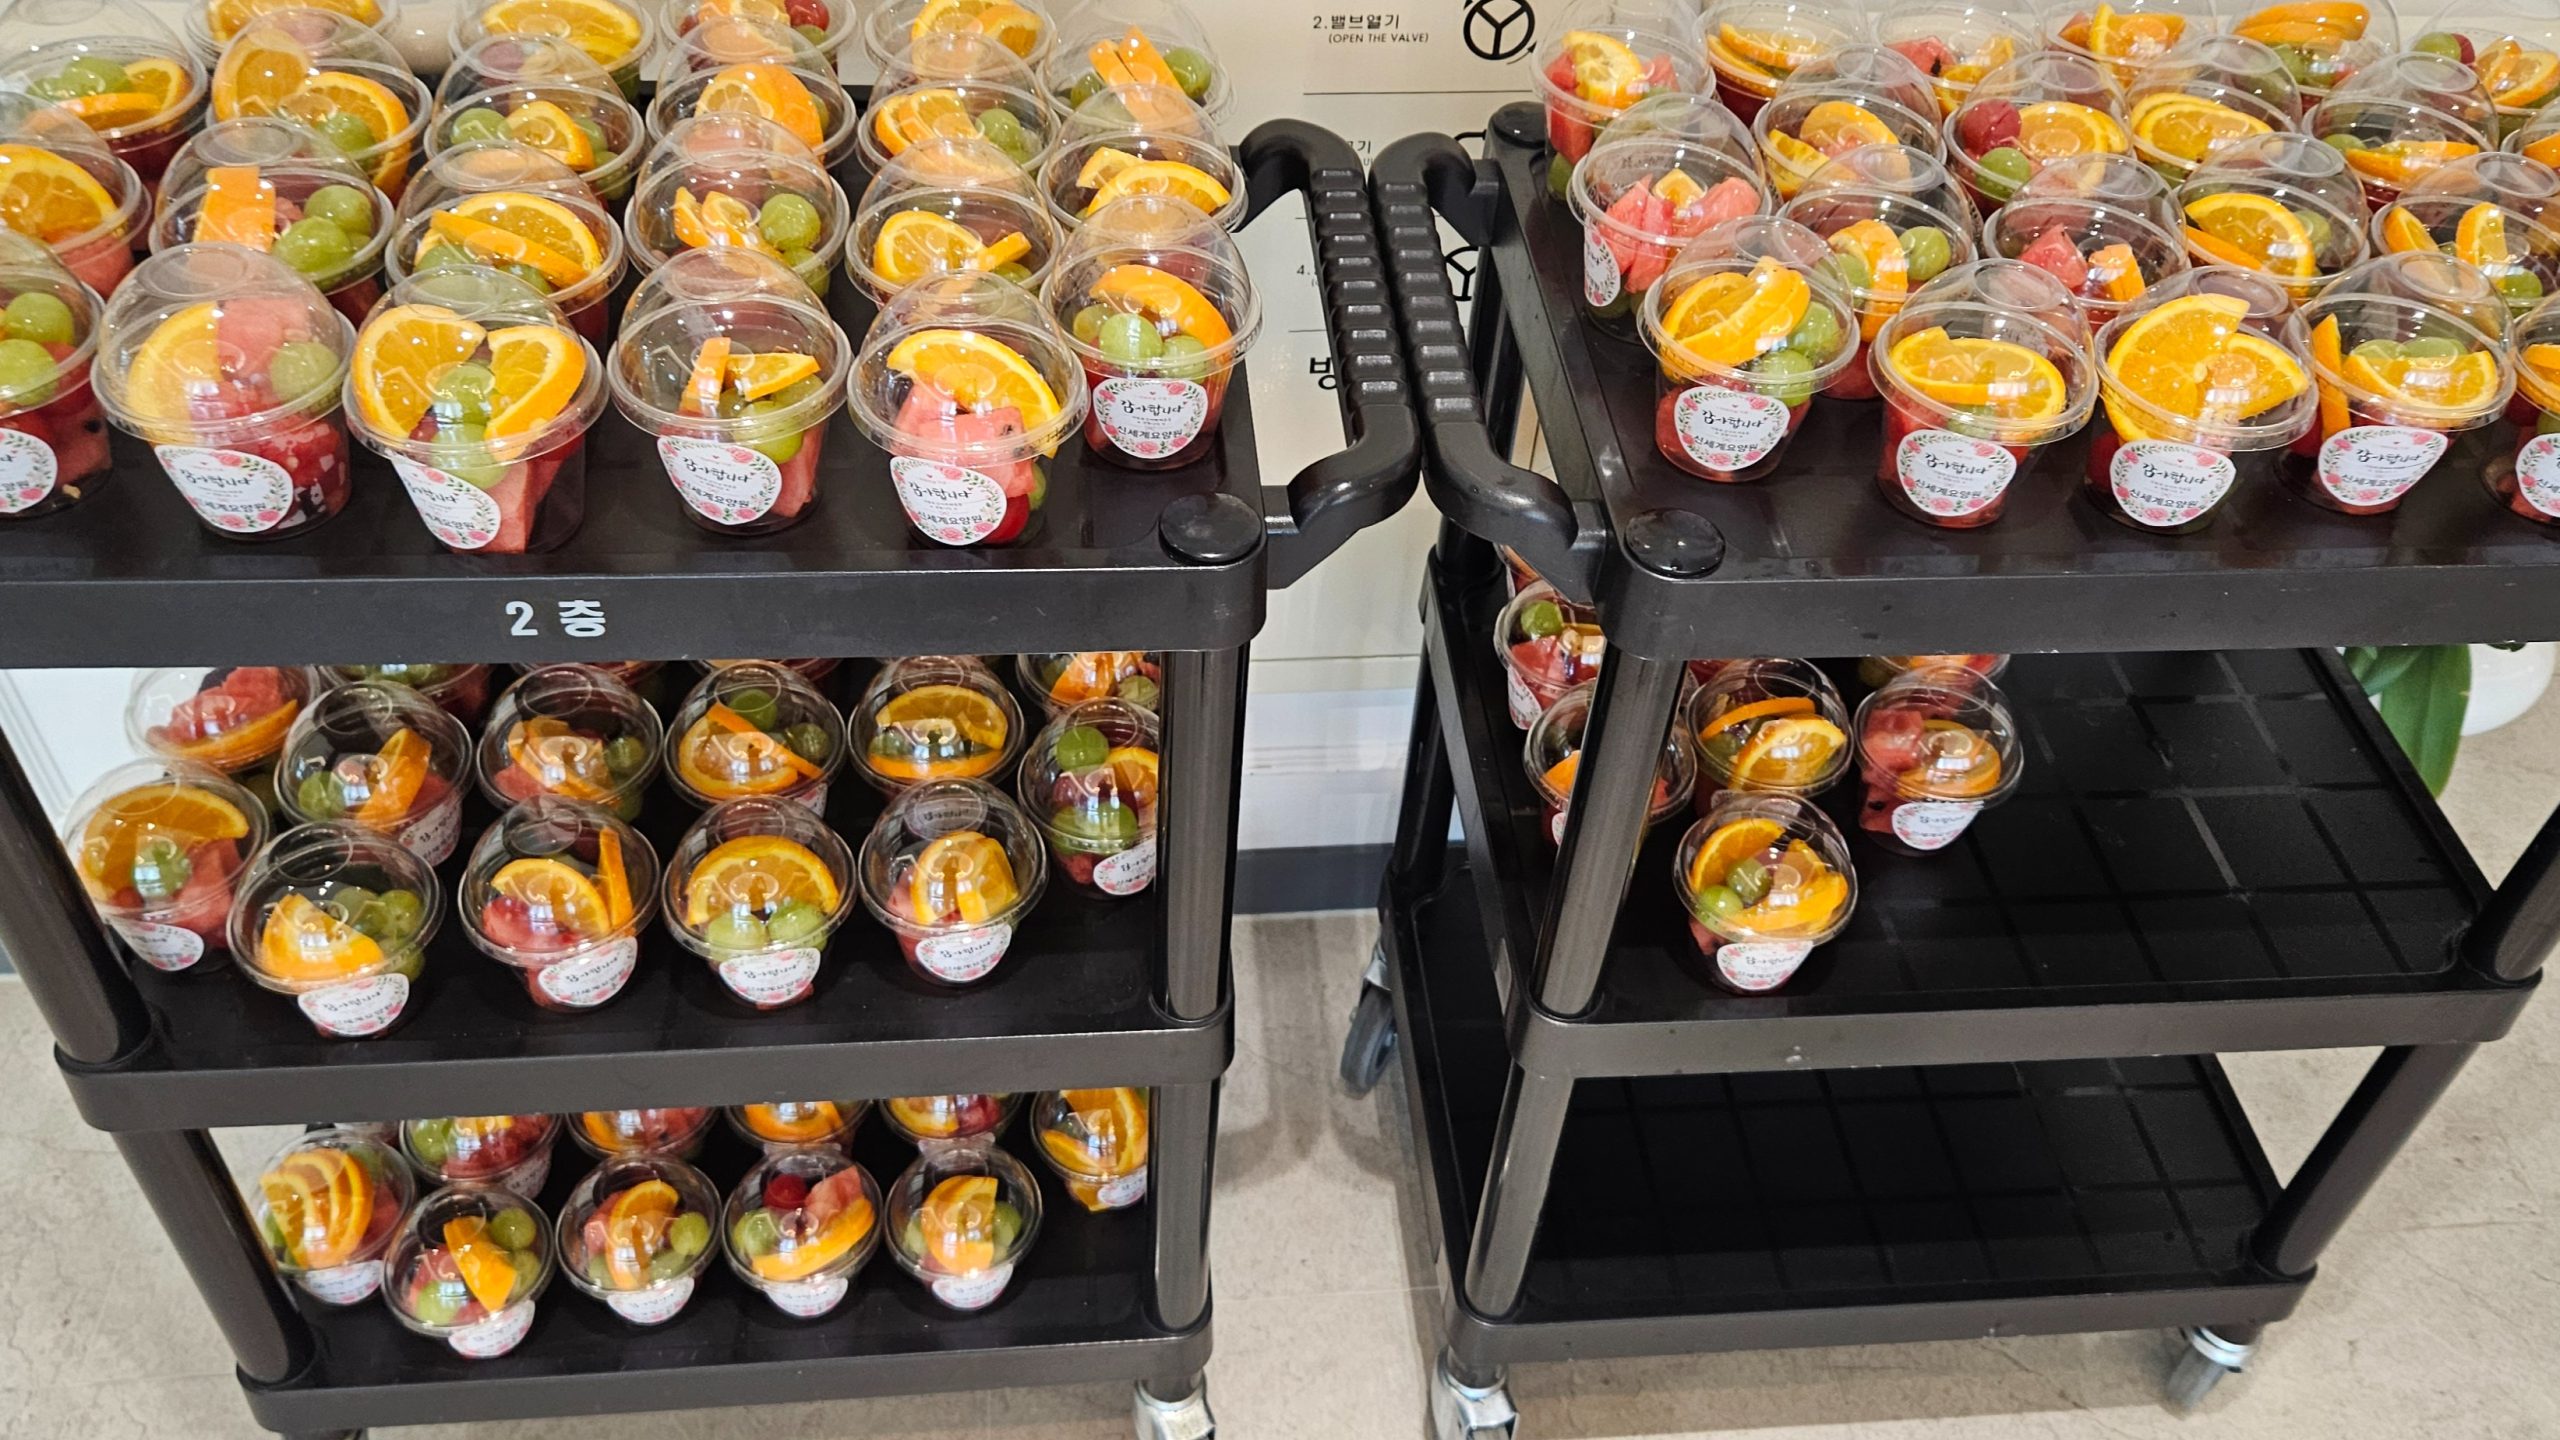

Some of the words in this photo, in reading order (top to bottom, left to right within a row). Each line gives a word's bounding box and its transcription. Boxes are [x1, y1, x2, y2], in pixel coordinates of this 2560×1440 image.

[1328, 33, 1364, 44] (OPEN
[1368, 33, 1387, 43] THE
[1391, 33, 1429, 43] VALVE)
